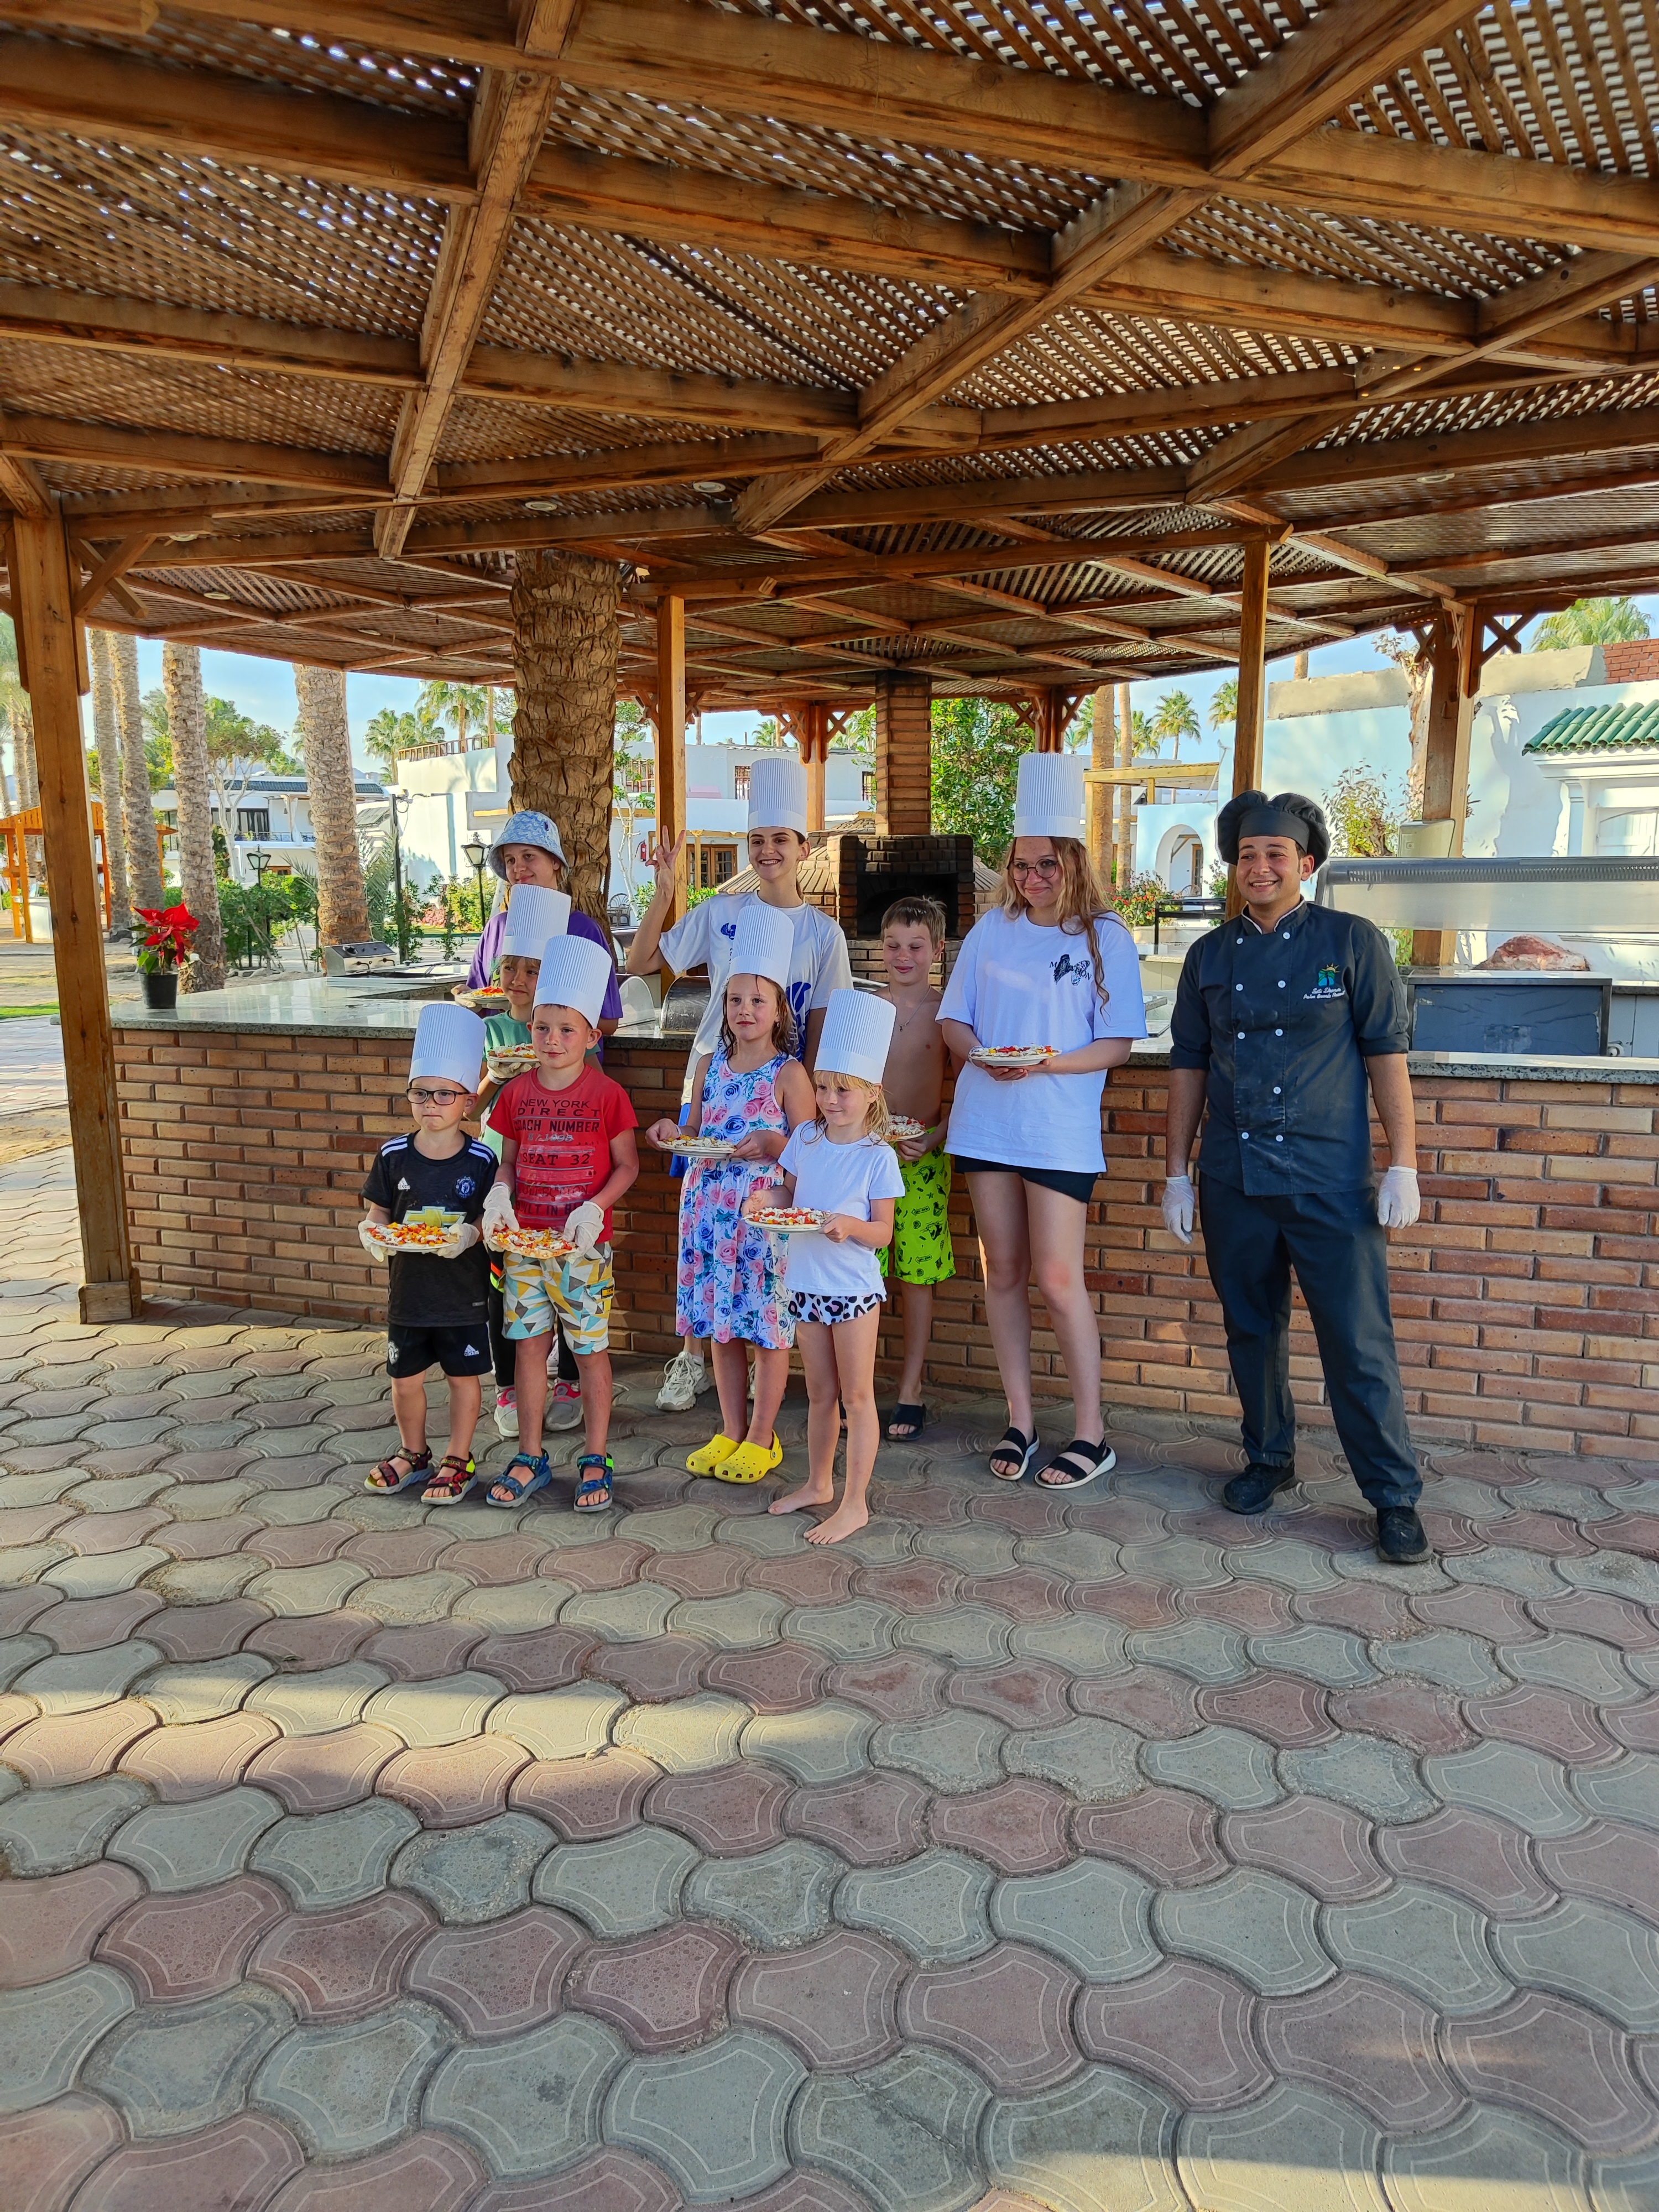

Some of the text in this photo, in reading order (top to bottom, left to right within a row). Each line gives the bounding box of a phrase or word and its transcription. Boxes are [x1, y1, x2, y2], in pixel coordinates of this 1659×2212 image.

[520, 1098, 590, 1109] NEW YORK
[518, 1107, 601, 1117] DIRECT
[549, 1120, 600, 1133] NUMBER
[522, 1152, 559, 1166] SEAT
[570, 1154, 590, 1165] 32
[546, 1204, 558, 1216] IN
